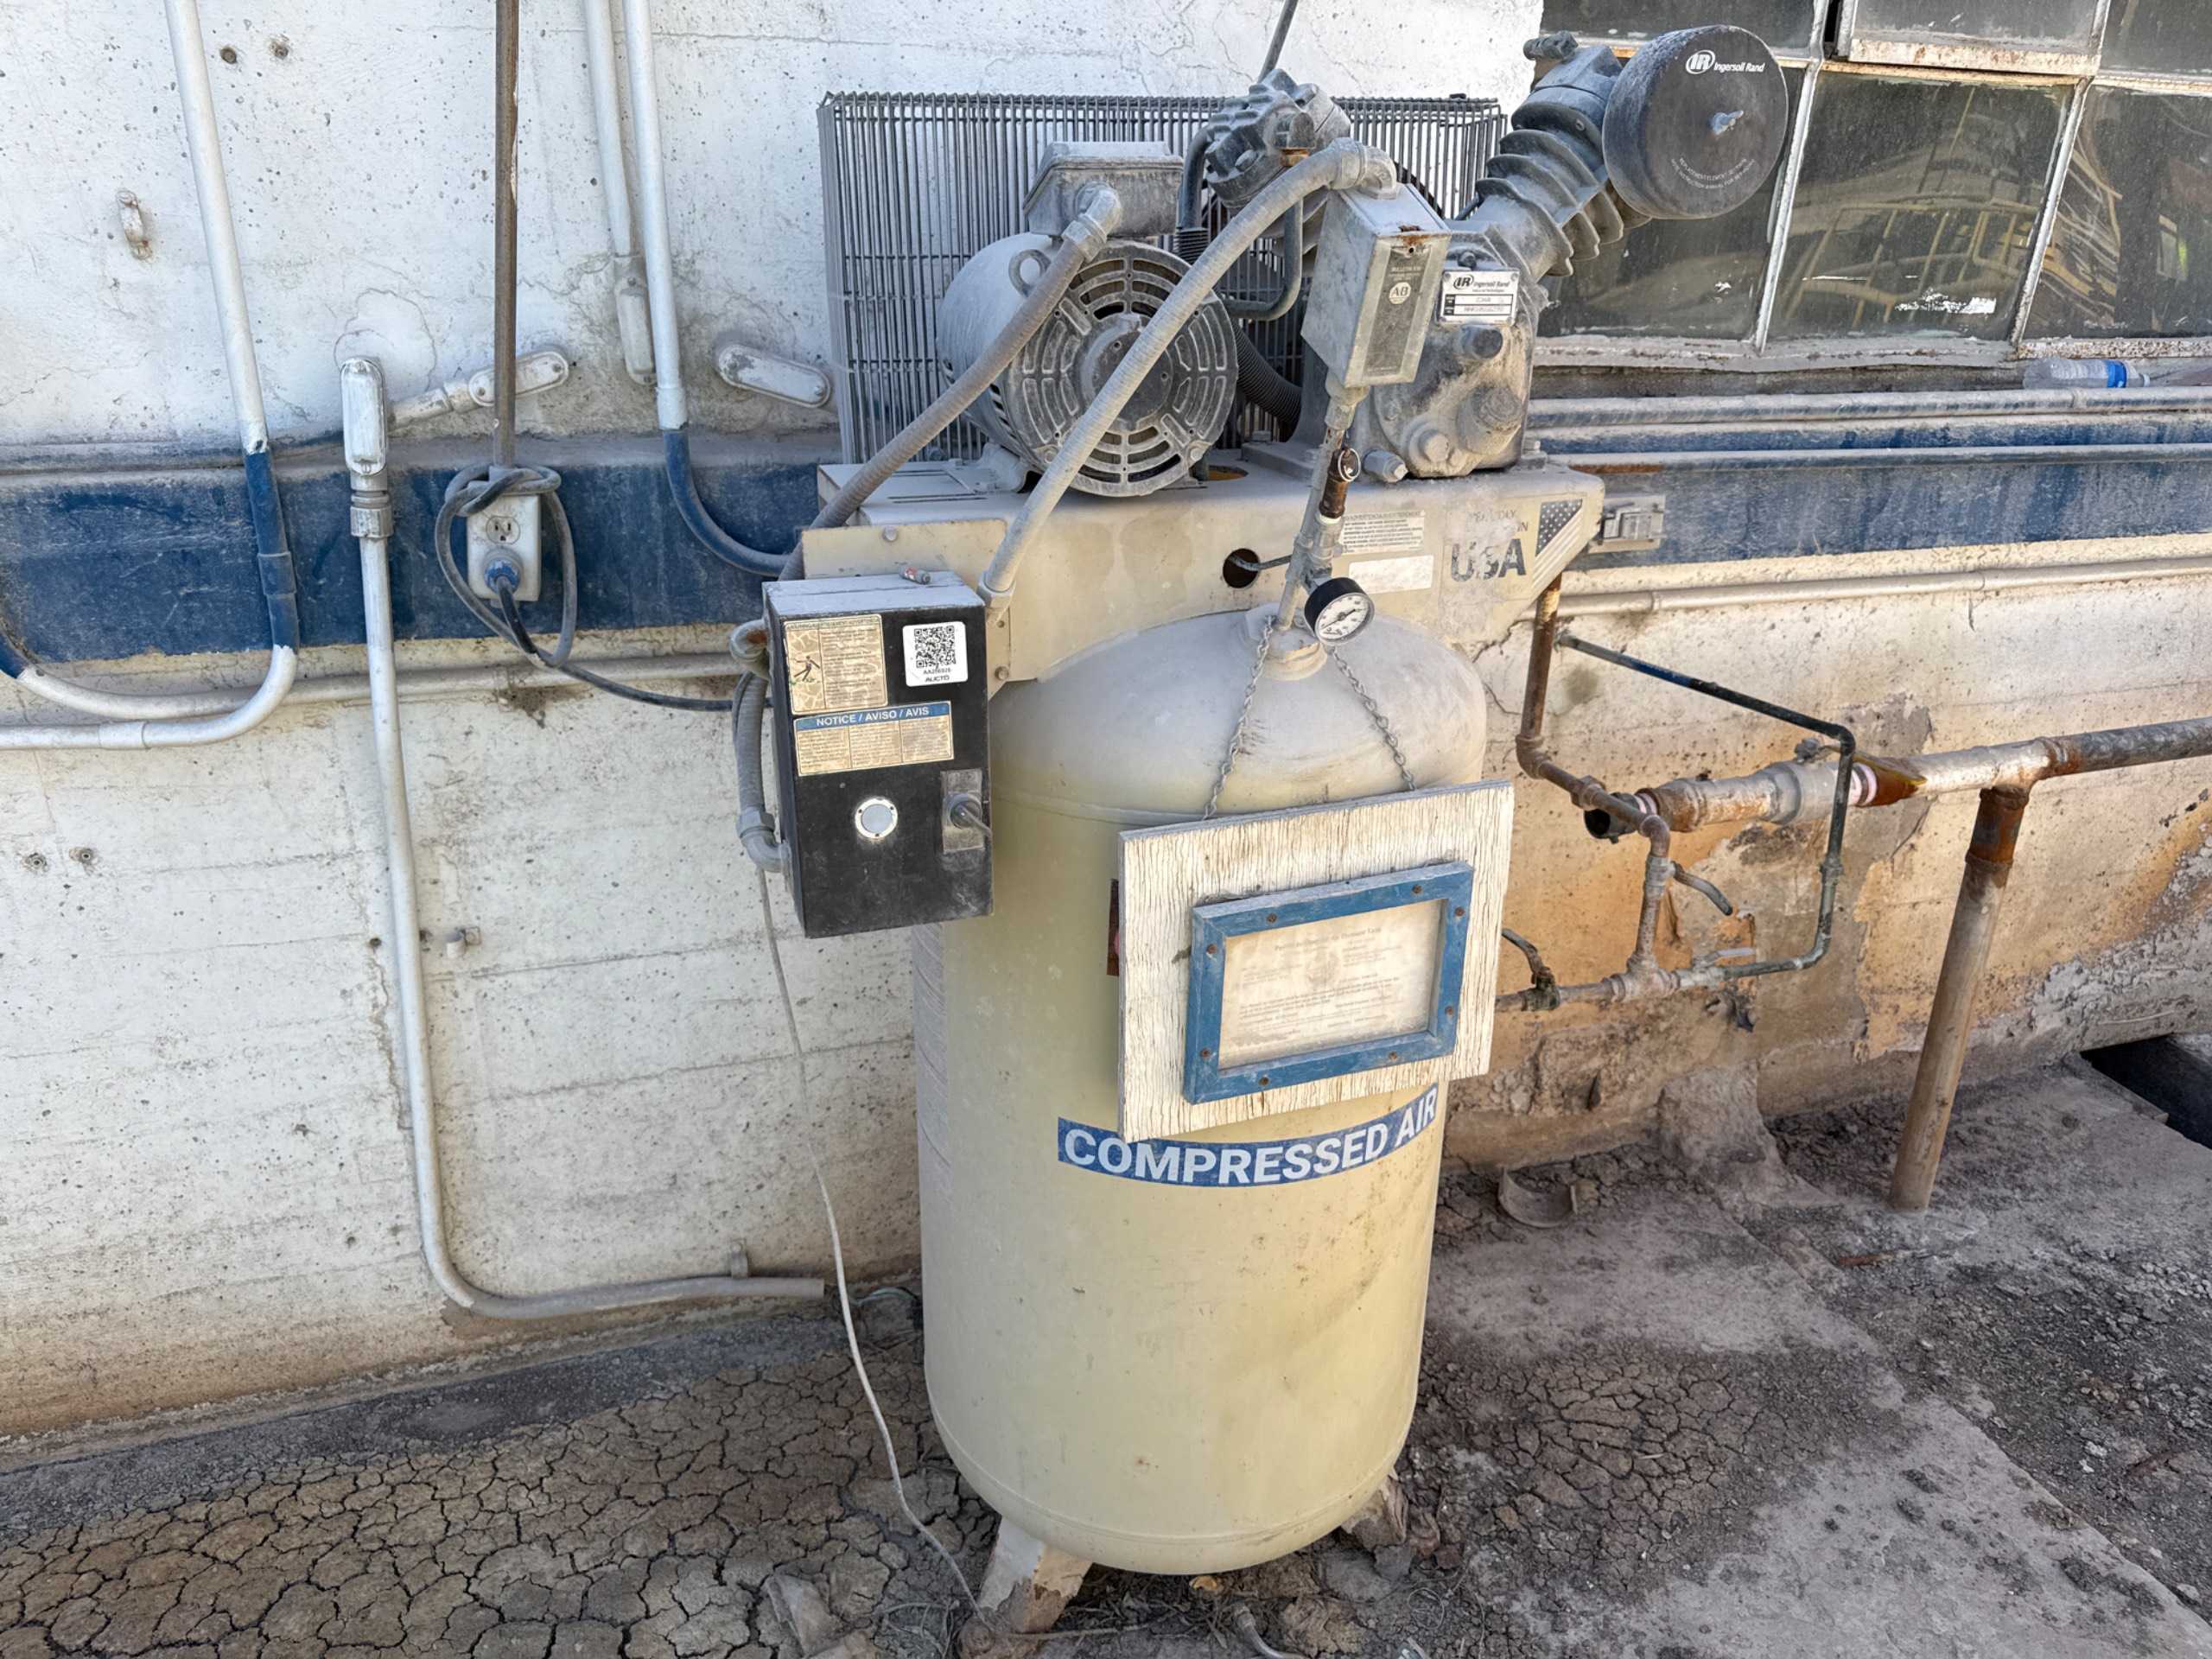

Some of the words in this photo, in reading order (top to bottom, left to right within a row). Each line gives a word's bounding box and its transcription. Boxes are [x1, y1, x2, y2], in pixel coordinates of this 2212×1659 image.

[1714, 61, 1745, 73] Ingersoll
[1745, 62, 1765, 73] Rand
[1452, 538, 1527, 582] USA
[816, 715, 856, 727] NOTICE
[865, 710, 898, 721] AVISO
[906, 707, 930, 717] AVIS
[1064, 1122, 1389, 1185] COMPRESSED
[1395, 1091, 1438, 1145] AIR
